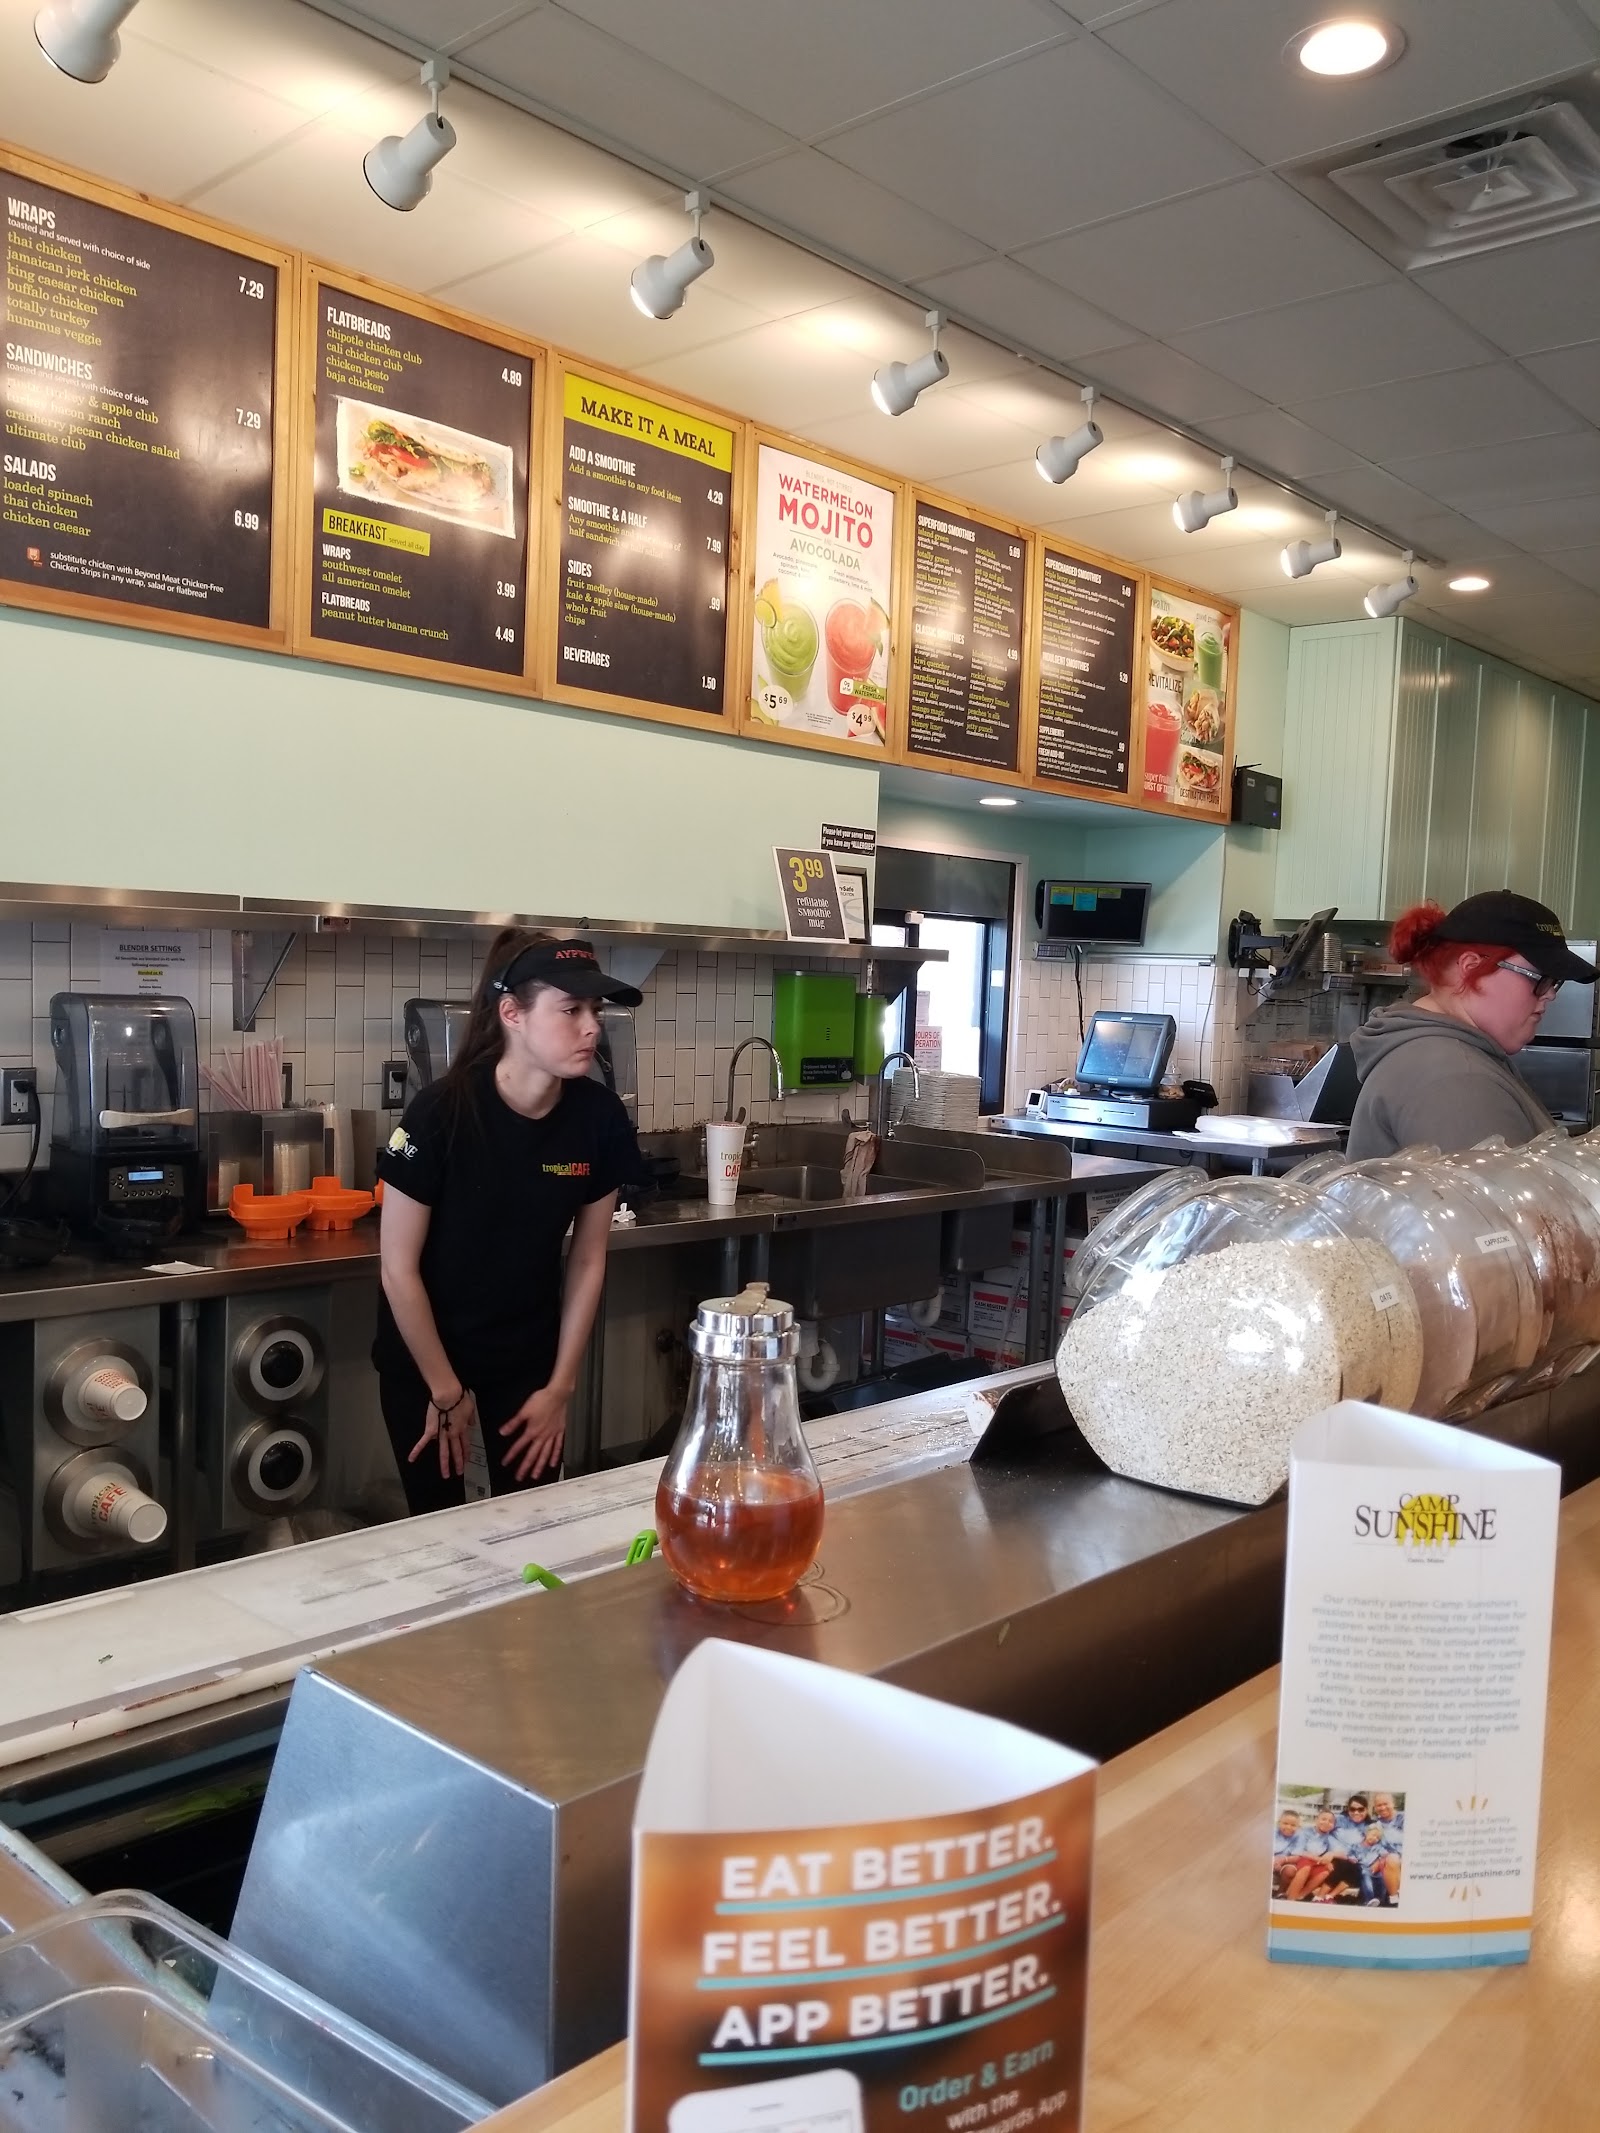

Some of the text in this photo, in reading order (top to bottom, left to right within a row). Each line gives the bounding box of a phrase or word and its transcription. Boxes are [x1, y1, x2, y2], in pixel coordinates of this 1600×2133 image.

[8, 197, 55, 229] WRAPS
[8, 217, 150, 270] toasted and served with choice of side
[8, 231, 82, 264] thai chicken
[7, 248, 137, 297] jamaican jerk chicken
[7, 262, 124, 307] king caesar chicken
[7, 278, 98, 315] buffalo chicken
[238, 276, 264, 299] 7.29
[7, 296, 90, 328] totally turkey
[327, 306, 391, 340] FLATBREADS
[6, 311, 102, 347] hummus veggie
[326, 328, 422, 365] chipotle chicken club
[326, 342, 403, 372] cali chicken club
[6, 343, 92, 380] SANDWICHES
[326, 355, 389, 381] chicken pesto
[326, 367, 384, 394] baja chicken
[501, 367, 522, 387] 4.89
[88, 412, 121, 429] ranch
[101, 400, 158, 424] apple club
[236, 408, 261, 430] 7.29
[5, 407, 180, 460] cranberry pecan chicken salad
[5, 422, 86, 450] ultimate club
[581, 397, 716, 458] MAKE IT A MEAL
[4, 455, 56, 482] SALADS
[569, 445, 636, 477] ADD SMOOTHIE
[4, 477, 93, 507] loaded spinach
[569, 463, 682, 503] Add smoothie any food item
[779, 473, 872, 520] WATERMELON
[3, 494, 78, 519] thai chicken
[707, 489, 724, 506] 4.29
[3, 510, 91, 537] chicken caesar
[234, 509, 259, 531] 6.99
[568, 496, 648, 529] SMOOTHIE & HALF
[779, 494, 873, 548] MOJITO
[328, 515, 388, 541] BREAKFAST
[918, 515, 975, 543] SUPERFOOD SMOOTHIES
[322, 543, 351, 560] WRAPS
[706, 537, 722, 554] 7.99
[790, 538, 860, 571] AVOCOLADA
[50, 551, 224, 593] substitute chicken with Beyond Meat Chicken-Free
[50, 560, 207, 599] Chicken Strips any wrap, salad flatbread
[322, 560, 402, 584] southwest omelet
[567, 559, 592, 578] SIDES
[322, 573, 411, 599] all american omelet
[496, 581, 515, 599] 3.99
[567, 577, 658, 608] fruit medley (house-made)
[321, 592, 370, 612] FLATBREADS
[565, 601, 607, 618] whole fruit
[566, 589, 677, 623] kale apple slaw (house-made)
[321, 607, 449, 641] peanut butter banana crunch
[565, 614, 586, 626] chips
[495, 626, 515, 643] 4.49
[564, 646, 610, 668] BEVERAGES
[701, 675, 716, 690] 1.50
[823, 826, 836, 836] Please
[808, 918, 825, 929] mug
[120, 944, 149, 952] BLENDER
[542, 1163, 571, 1173] tropical
[572, 1163, 590, 1175] CAFE
[1399, 1493, 1460, 1512] CAMP
[1354, 1504, 1497, 1541] SUNSHINE
[721, 1816, 1055, 1900] EAT BETTER.
[1409, 1869, 1520, 1880] www.CampSunshine.org
[704, 1881, 1062, 1975] FEEL BETTER.
[712, 1954, 1049, 2049] APP BETTER.
[899, 2040, 1054, 2112] Order & Earn
[946, 2089, 1020, 2130] with the
[1038, 2090, 1067, 2117] App
